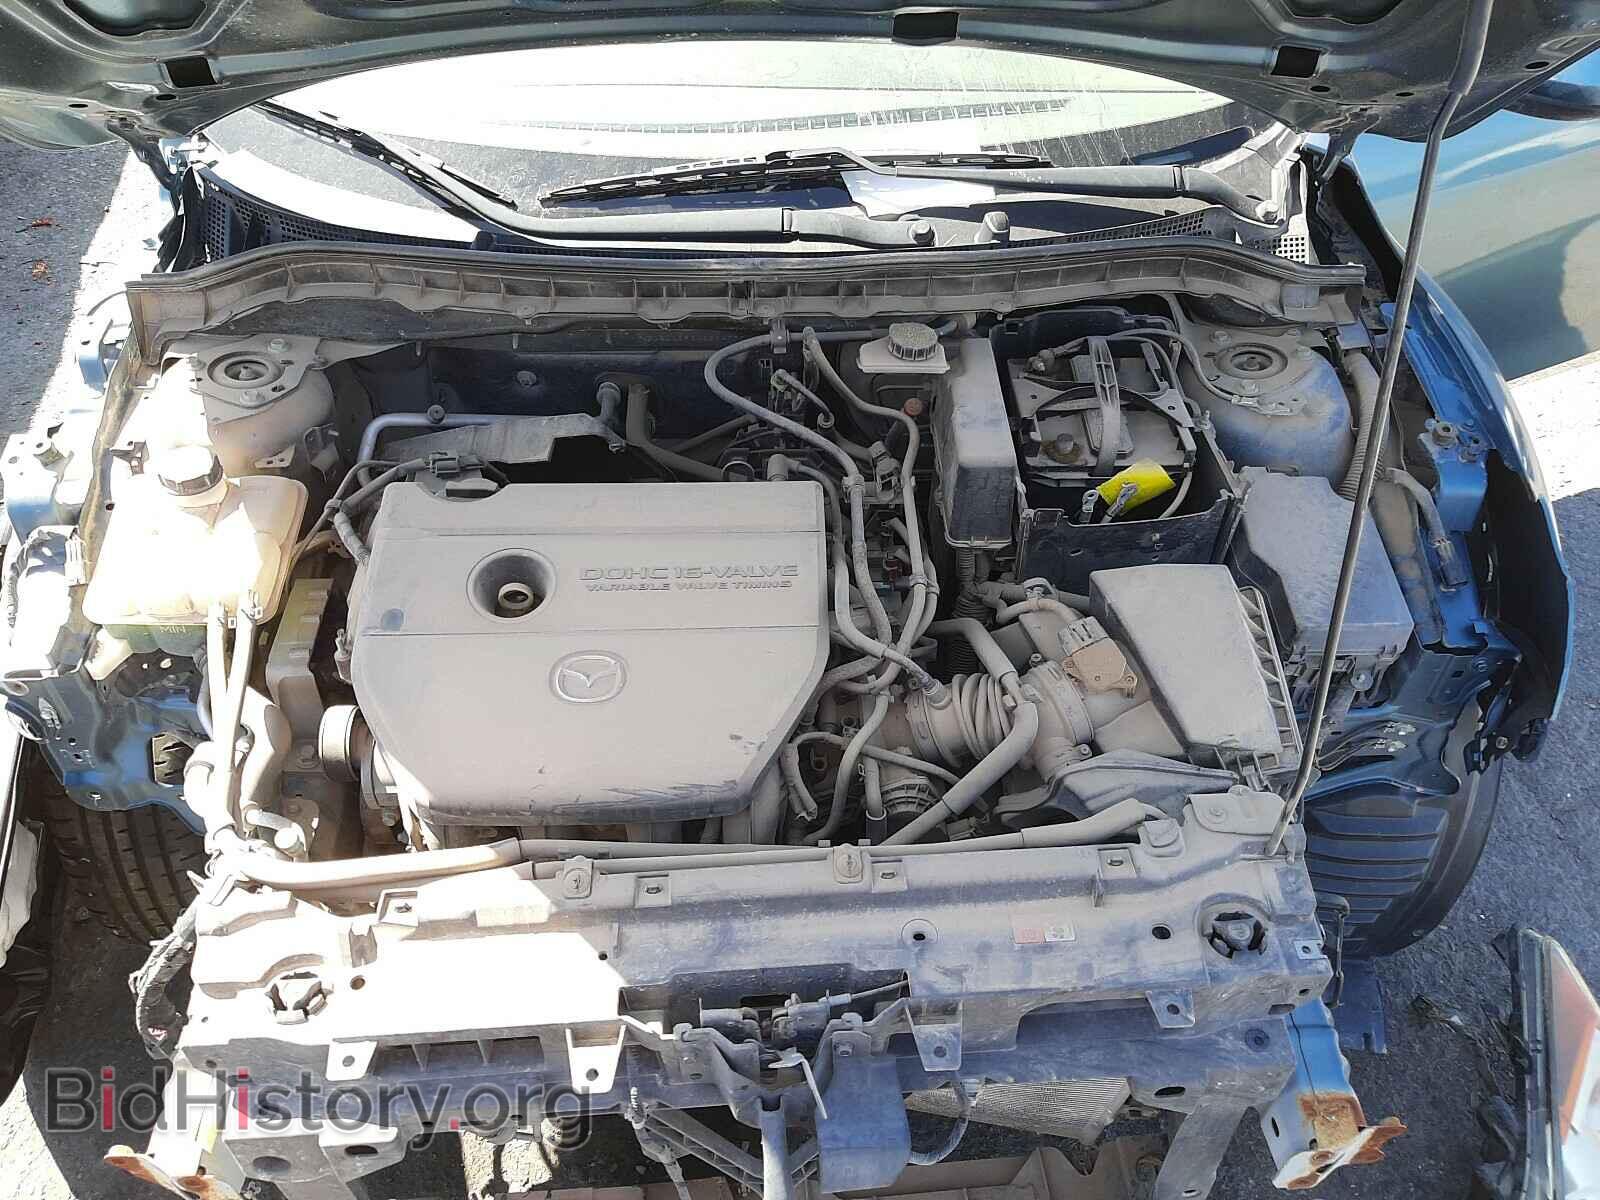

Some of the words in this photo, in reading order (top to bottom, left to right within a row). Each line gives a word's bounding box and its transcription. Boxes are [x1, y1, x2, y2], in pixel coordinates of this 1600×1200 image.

[580, 567, 668, 581] DOHC
[586, 583, 671, 592] VARIABLE
[676, 582, 729, 590] VALVE
[733, 580, 793, 589] TIMING
